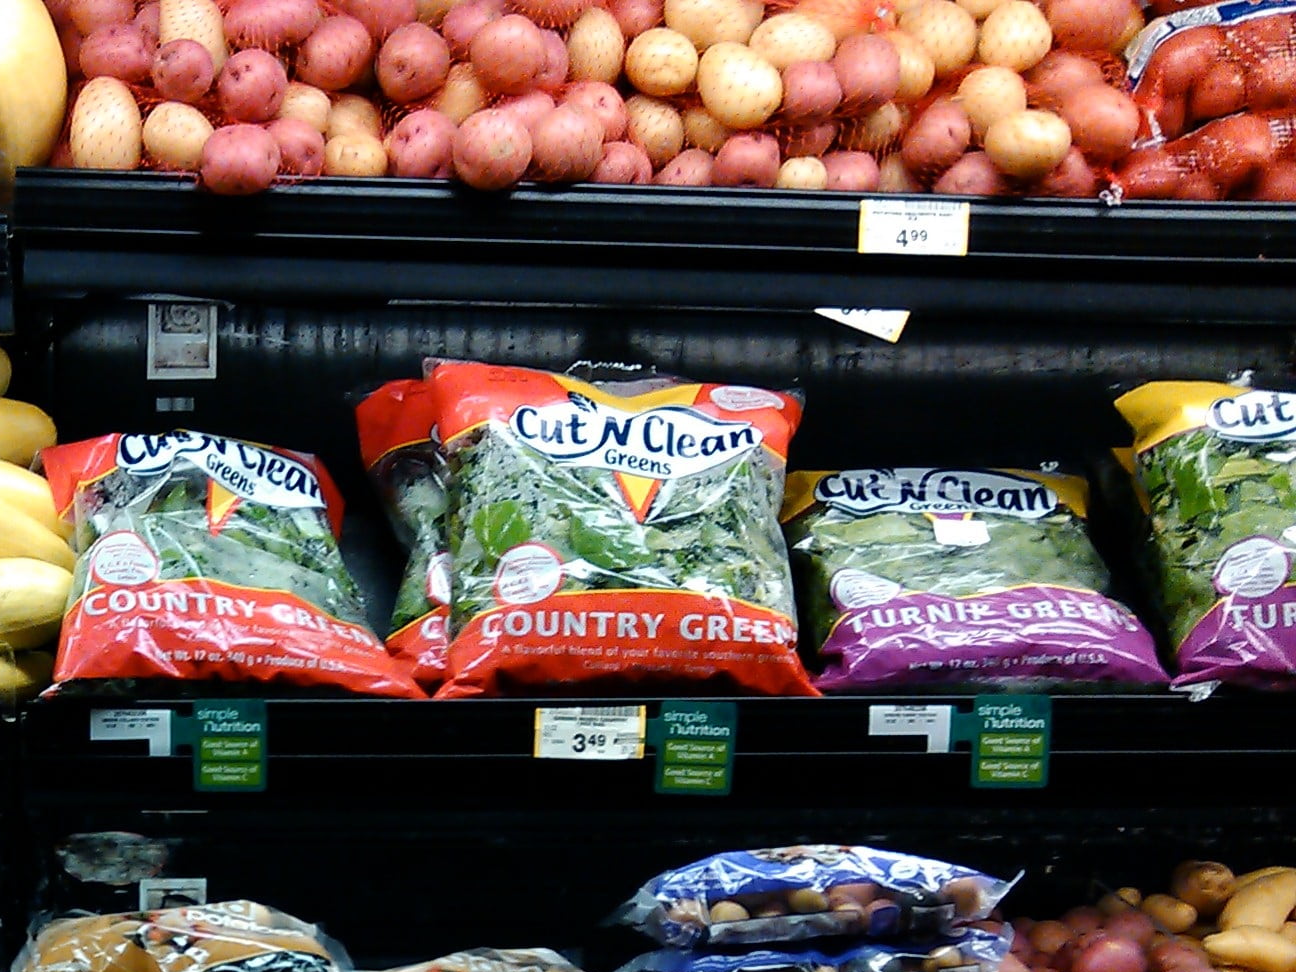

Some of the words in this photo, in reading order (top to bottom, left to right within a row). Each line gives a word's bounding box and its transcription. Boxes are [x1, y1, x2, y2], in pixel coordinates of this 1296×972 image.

[1214, 395, 1294, 429] Cut
[516, 407, 588, 444] Cut
[642, 415, 754, 458] Clean
[206, 453, 257, 496] Greens
[605, 449, 671, 475] Greens
[819, 474, 890, 502] Cut
[938, 475, 1051, 511] Clean
[84, 590, 256, 618] COUNTRY
[271, 603, 385, 651] GREEN
[481, 610, 664, 639] COUNTRY
[197, 707, 238, 721] simple
[664, 710, 708, 724] simple
[978, 704, 1023, 718] simple
[572, 733, 606, 753] 349
